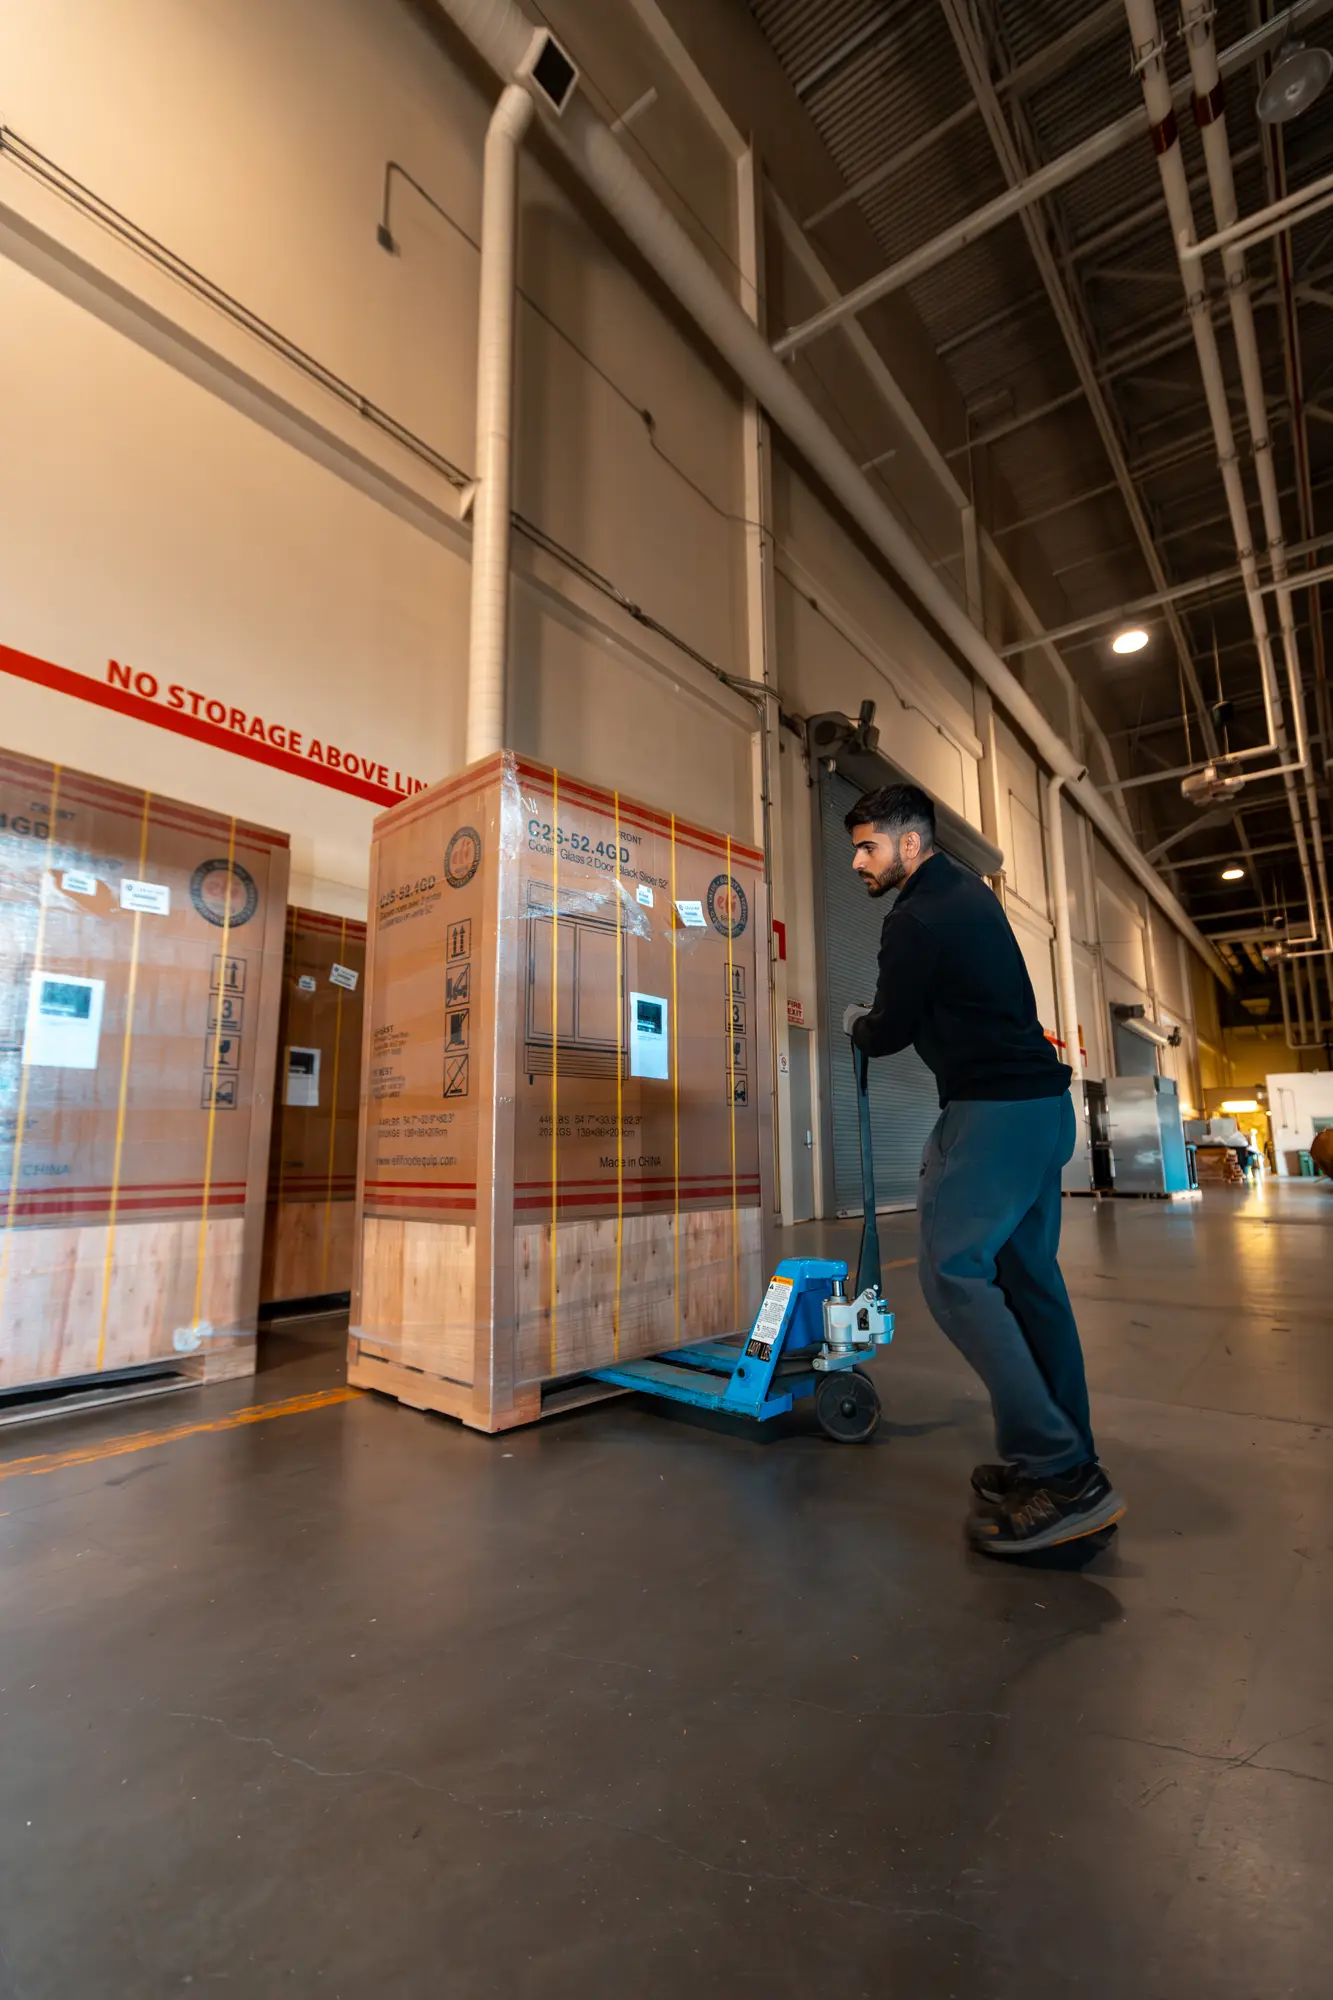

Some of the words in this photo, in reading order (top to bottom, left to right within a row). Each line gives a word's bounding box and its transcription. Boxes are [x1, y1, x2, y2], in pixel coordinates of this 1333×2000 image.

[107, 658, 158, 698] NO
[167, 684, 302, 754] STORAGE
[307, 739, 389, 787] ABOVE
[528, 819, 630, 864] C2S-52.4GD
[528, 839, 556, 856] Coole
[560, 848, 585, 865] Glass
[586, 856, 593, 867] 2
[595, 859, 615, 873] Door
[787, 1000, 802, 1010] FIRE
[787, 1007, 802, 1018] EXIT
[599, 1156, 626, 1168] Made
[628, 1156, 636, 1167] in
[638, 1155, 662, 1167] CHINA
